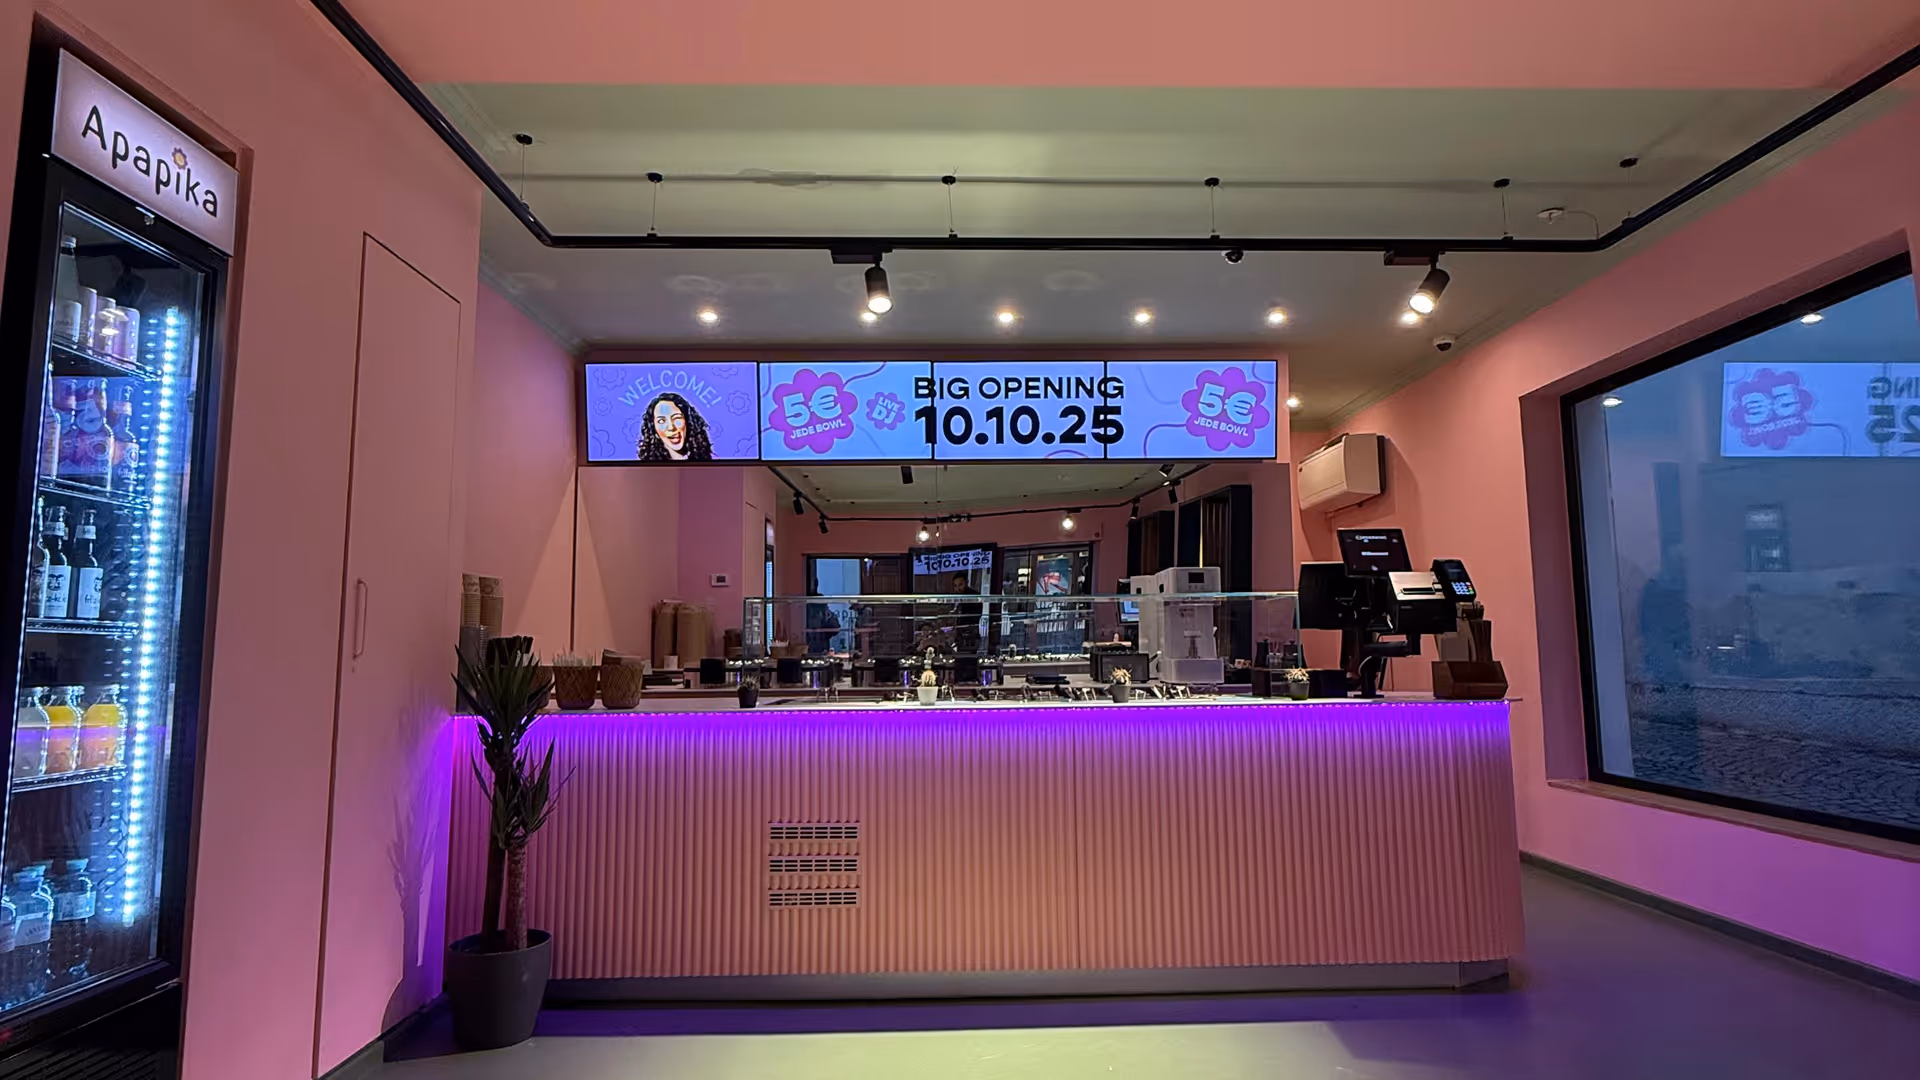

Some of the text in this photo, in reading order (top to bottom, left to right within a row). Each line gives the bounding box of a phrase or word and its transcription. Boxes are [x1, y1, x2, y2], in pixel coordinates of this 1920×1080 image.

[81, 105, 218, 217] Apapika
[618, 370, 722, 408] WELCOME!
[914, 376, 1124, 399] BIG OPENING
[783, 385, 842, 427] 5€
[872, 405, 897, 424] DJ
[878, 397, 900, 411] LIVE
[1198, 382, 1257, 425] 5€
[790, 419, 846, 439] JEDE BOWL
[914, 405, 1124, 445] 10.10.25
[1194, 417, 1249, 437] JEDE BOWL
